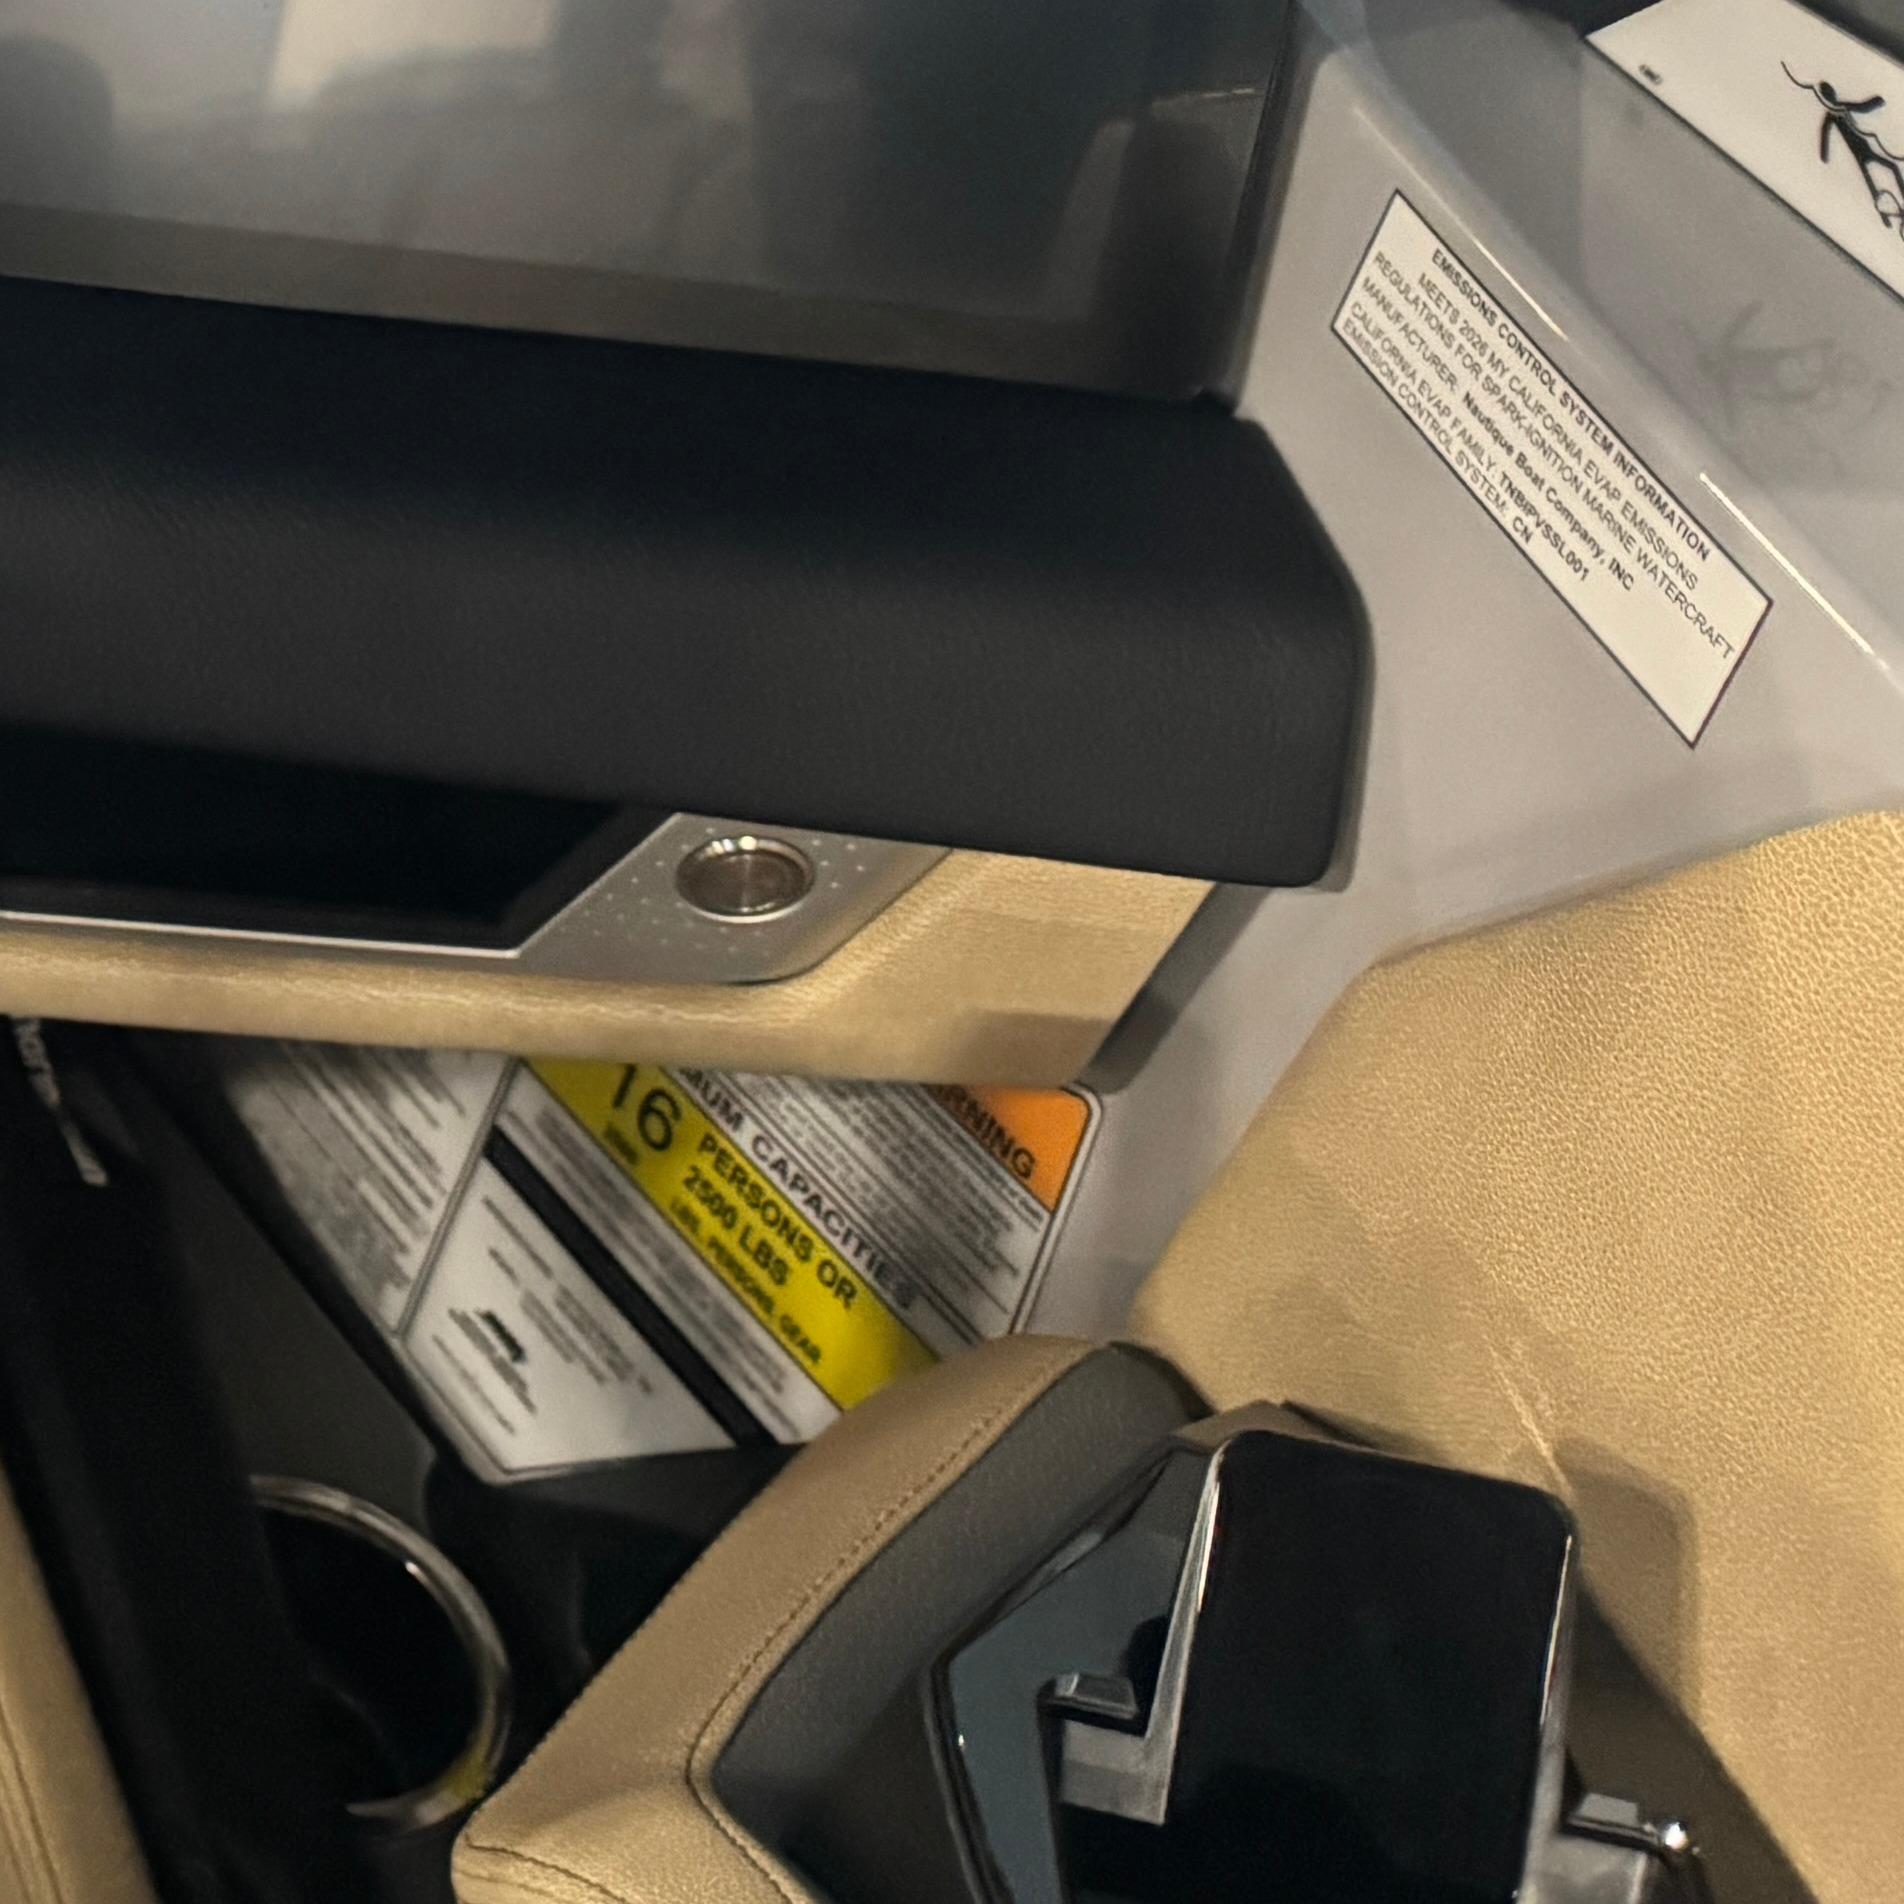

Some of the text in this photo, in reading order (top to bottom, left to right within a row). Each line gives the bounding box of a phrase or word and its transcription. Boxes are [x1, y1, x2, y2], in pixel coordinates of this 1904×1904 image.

[1341, 316, 1398, 388] EMISSION
[1396, 380, 1456, 454] CONTROL
[1511, 514, 1533, 545] CN
[1349, 300, 1419, 385] CALIFORNIA
[1417, 378, 1451, 423] EVAP
[1373, 250, 1734, 663] REGULATIONS FOR SPARK-IGNITION MARINE WATERCRAFT
[1417, 271, 1698, 592] MEETS 2026 MY CALIFORNIA EVAP EMISSIONS
[1431, 247, 1710, 562] EMISSIONS CONTROL SYSTEM INFORMATION
[1460, 390, 1516, 460] Nautique
[1514, 450, 1547, 493] Boat
[1542, 484, 1610, 567] Company,
[1607, 556, 1635, 592] INC
[612, 1062, 683, 1152] 16
[698, 1131, 819, 1264] PERSONS
[812, 1256, 859, 1309] OR
[749, 1133, 919, 1312] CAPACITIES
[927, 1083, 1036, 1179] RNING
[737, 1224, 794, 1288] LBS
